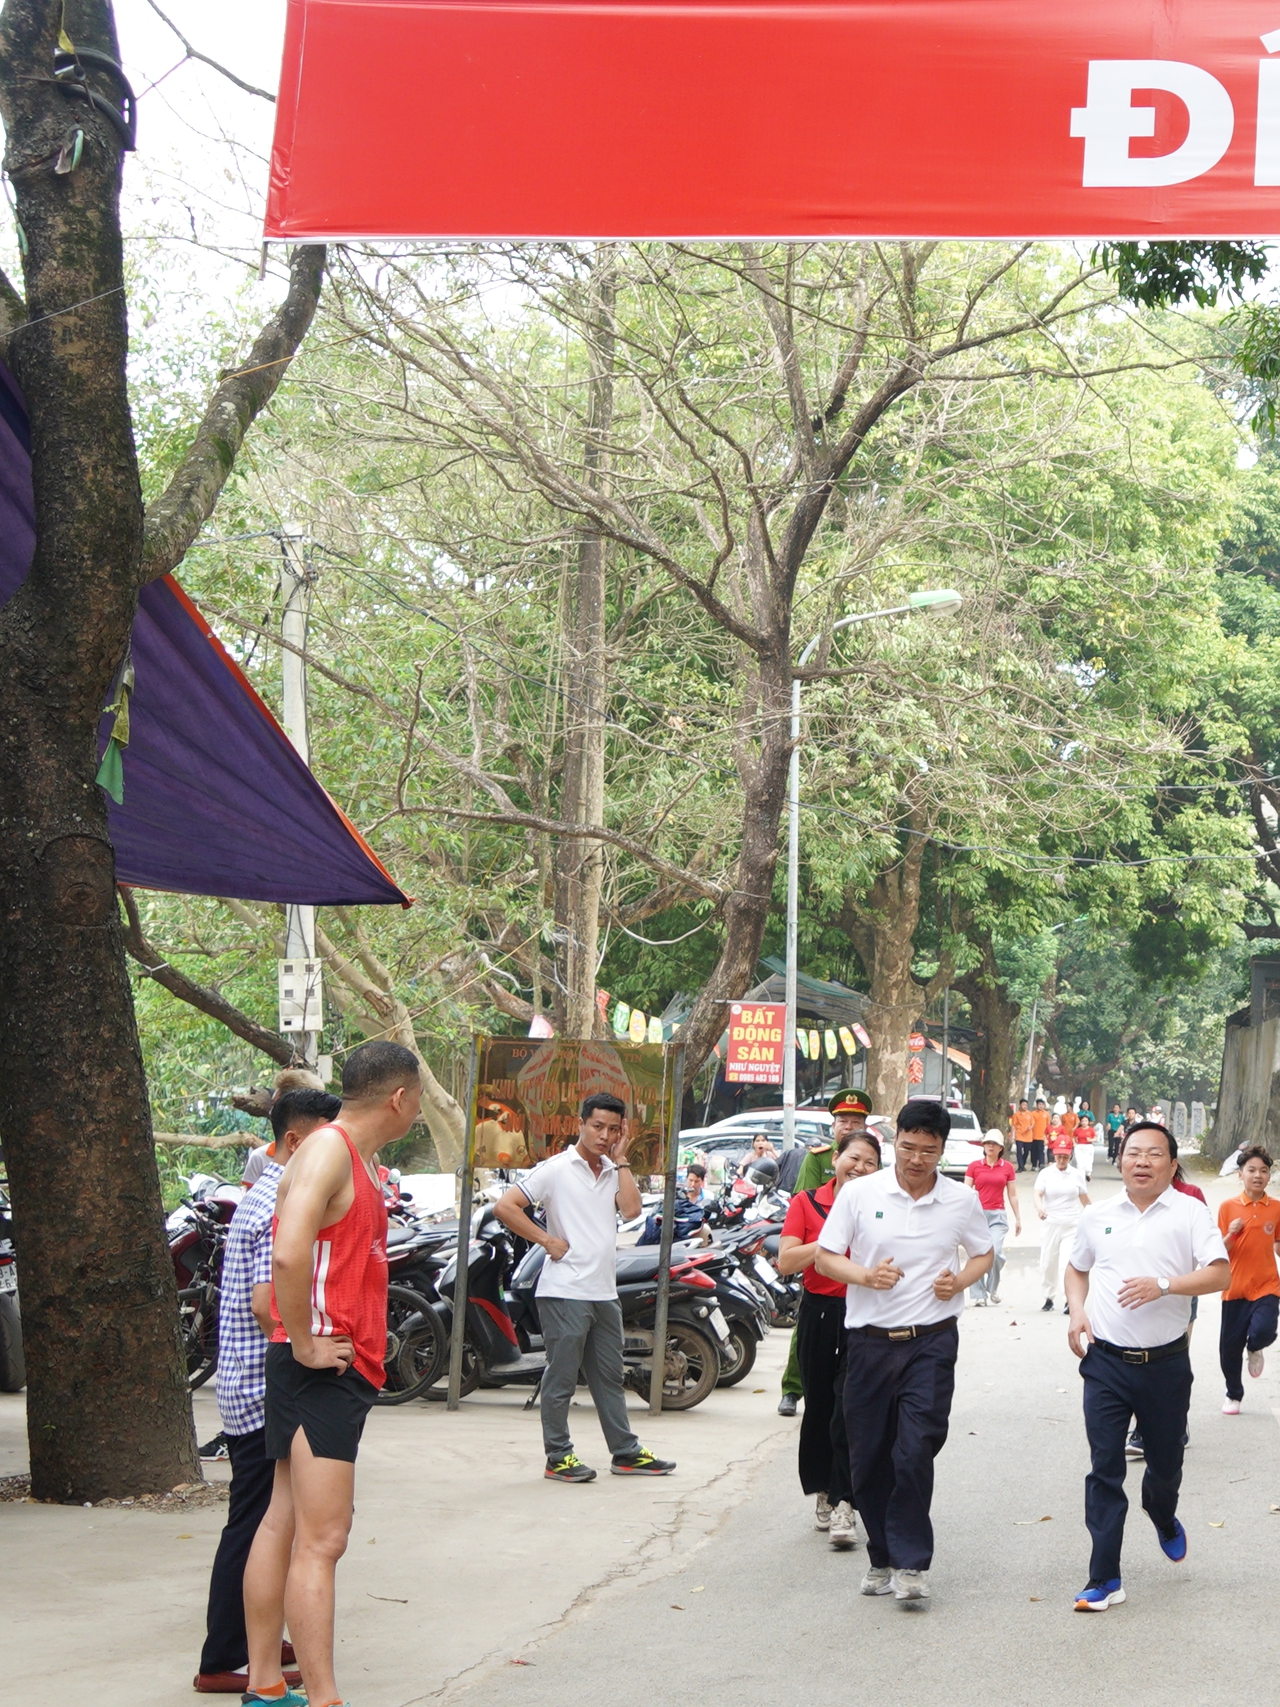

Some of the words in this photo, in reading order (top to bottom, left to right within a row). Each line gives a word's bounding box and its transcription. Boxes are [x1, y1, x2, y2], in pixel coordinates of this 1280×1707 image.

[741, 1006, 775, 1025] BẤT
[732, 1025, 782, 1044] ĐỘNG
[737, 1043, 775, 1061] SẢN
[729, 1062, 748, 1071] NHƯ
[748, 1062, 781, 1074] NGUYỆT
[492, 1078, 516, 1100] KHU
